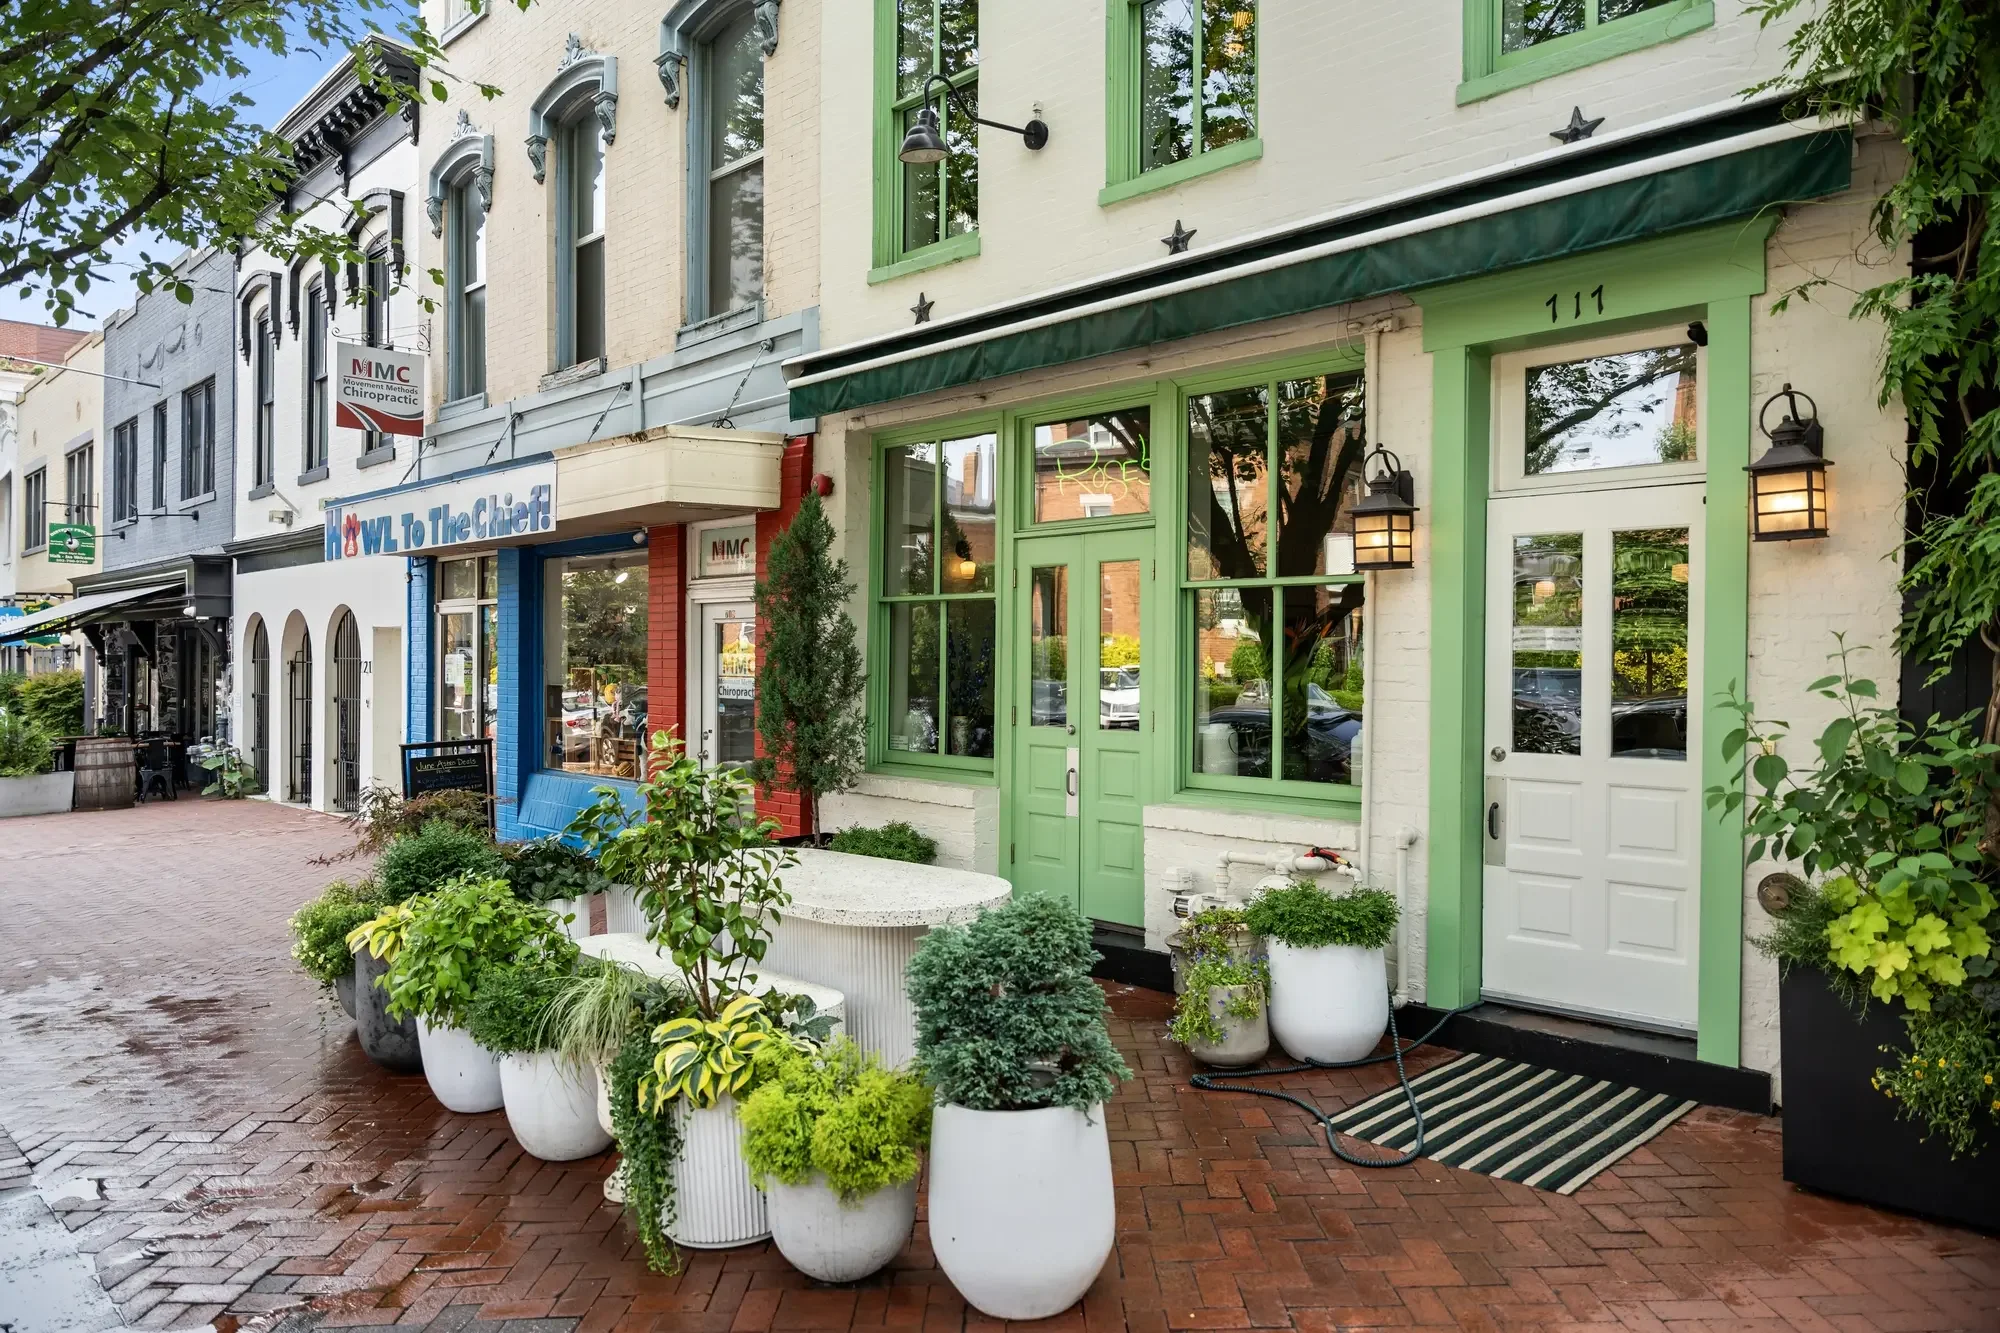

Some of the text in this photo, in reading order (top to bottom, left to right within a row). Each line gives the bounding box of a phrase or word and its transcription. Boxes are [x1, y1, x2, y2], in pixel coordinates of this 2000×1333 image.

[343, 377, 418, 395] Movement Methods
[343, 385, 418, 406] Chiropractic
[401, 512, 425, 549] To
[428, 504, 471, 545] The
[471, 484, 551, 539] Chief!
[718, 685, 754, 699] Chiropract
